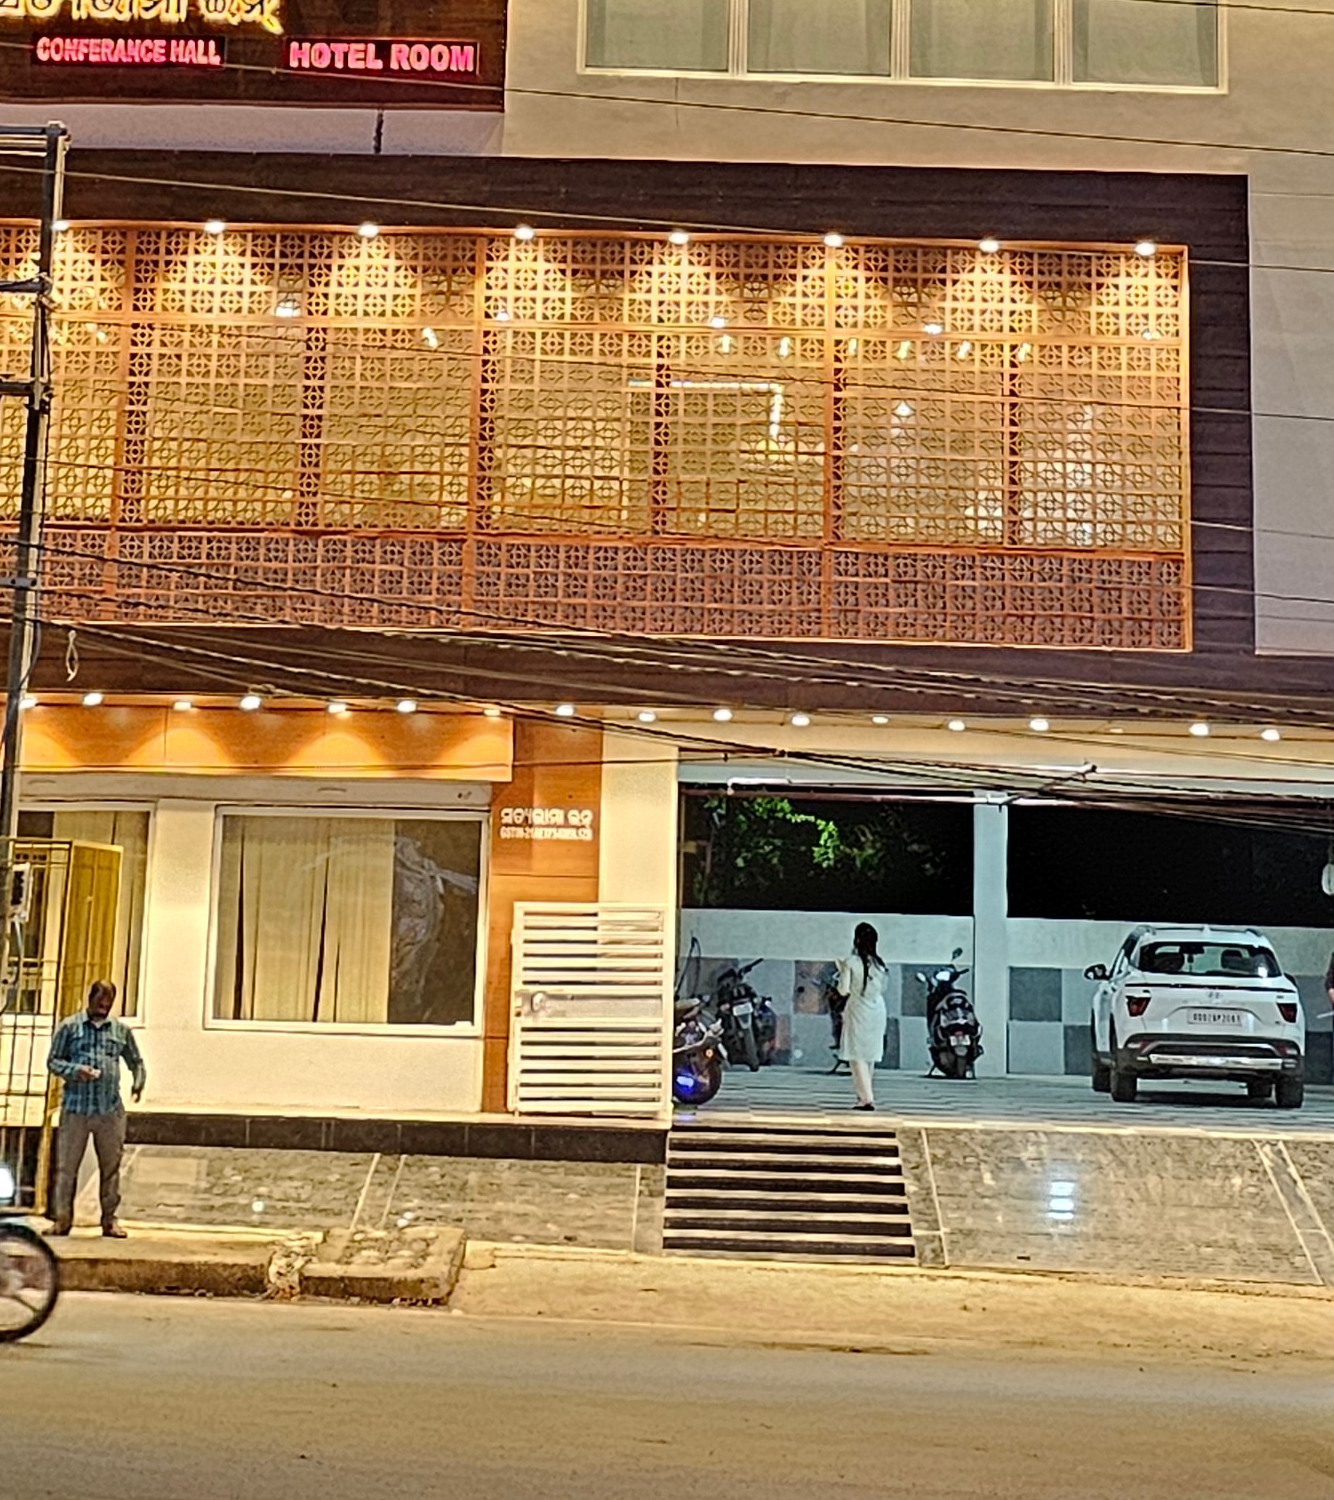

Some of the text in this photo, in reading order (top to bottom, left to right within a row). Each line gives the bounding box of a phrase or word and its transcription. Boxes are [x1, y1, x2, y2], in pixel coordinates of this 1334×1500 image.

[36, 37, 166, 64] CONFERANCE
[170, 40, 221, 66] HALL
[289, 41, 383, 71] HOTEL
[391, 44, 475, 72] ROOM
